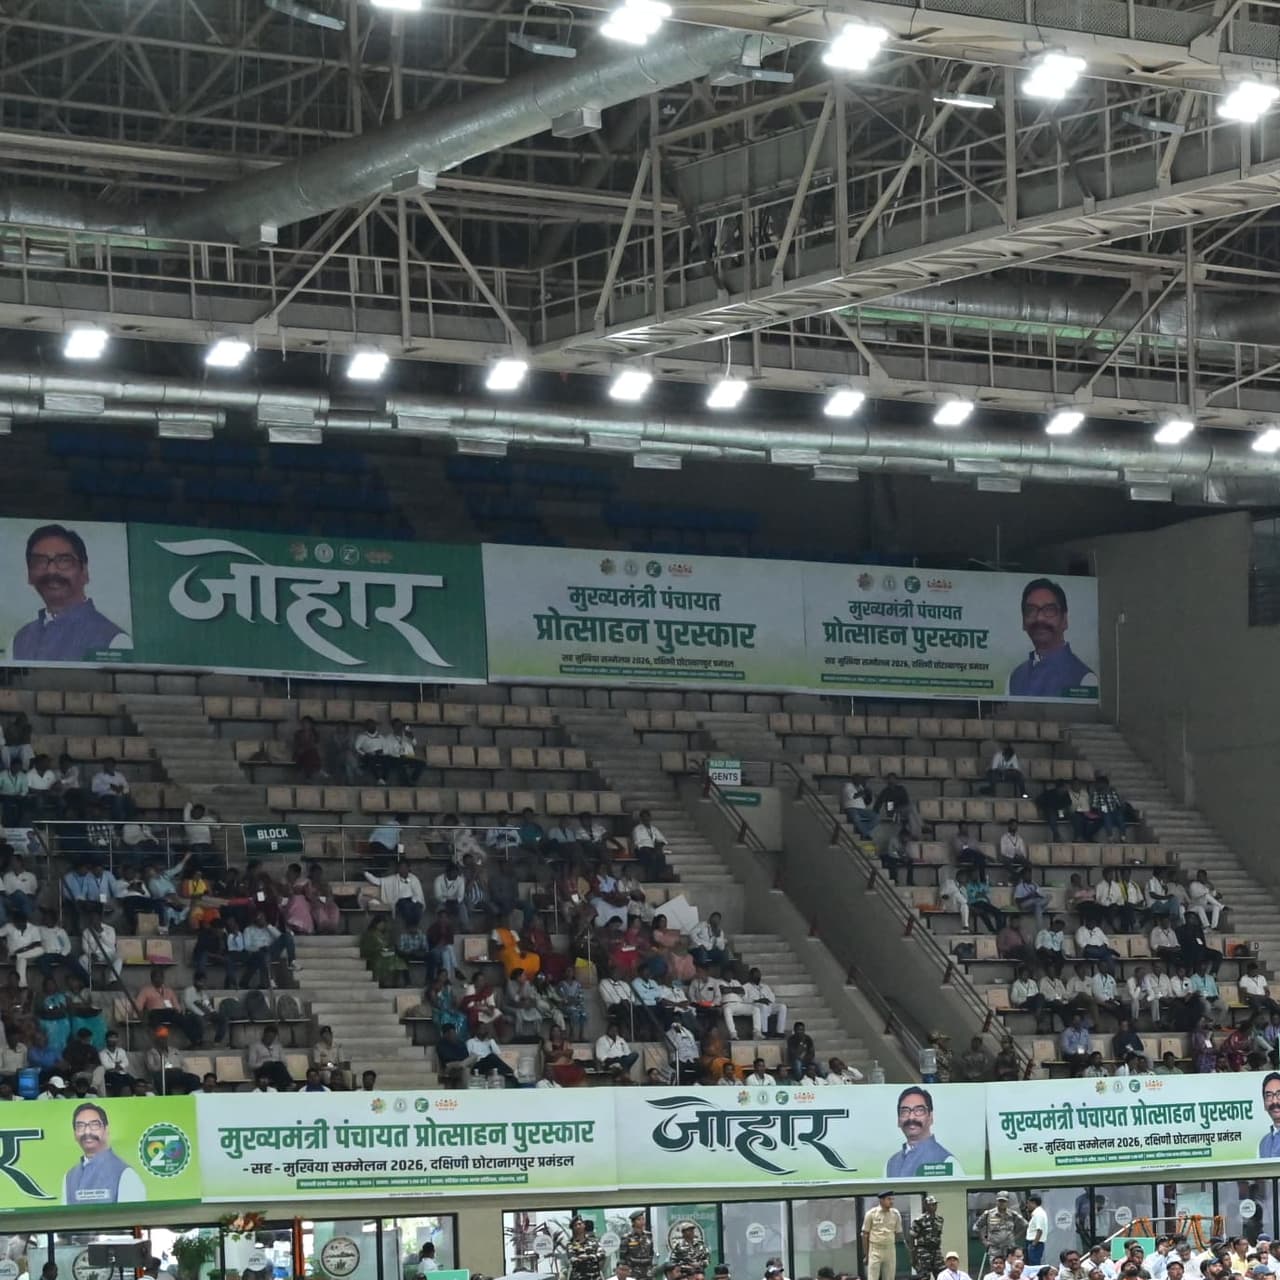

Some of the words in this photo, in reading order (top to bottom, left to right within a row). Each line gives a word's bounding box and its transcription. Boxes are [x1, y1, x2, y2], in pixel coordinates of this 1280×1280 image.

[154, 538, 455, 668] जोहार
[568, 585, 656, 611] मुख्यमंत्री
[660, 587, 721, 611] पंचायत
[848, 600, 914, 620] मुख्यमंत्री
[917, 602, 962, 620] पंचायत
[533, 607, 649, 644] प्रोत्साहन
[655, 620, 756, 652] पुरस्कार
[822, 615, 908, 645] प्रोत्साहन
[912, 627, 989, 653] पुरस्कार
[712, 772, 738, 781] GENTS
[257, 828, 288, 840] BLOCK
[646, 1095, 857, 1175] जोहार
[1000, 1103, 1073, 1139] मुख्यमंत्री
[1077, 1099, 1128, 1129] पंचायत
[1130, 1100, 1196, 1125] प्रोत्साहन
[1198, 1100, 1253, 1127] पुरस्कार
[218, 1118, 329, 1159] मुख्यमंत्री
[333, 1119, 409, 1150] पंचायत
[414, 1116, 507, 1147] प्रोत्साहन
[512, 1120, 595, 1154] पुरस्कार
[1045, 1140, 1076, 1154] मुखिया
[1077, 1138, 1114, 1151] सम्मेलन
[1144, 1134, 1171, 1146] दक्षिणी
[1173, 1132, 1216, 1146] छोटानागपुर
[1217, 1132, 1241, 1141] प्रमंडल
[283, 1159, 329, 1176] मुखिया
[332, 1158, 387, 1172] सम्मेलन
[430, 1156, 469, 1169] दक्षिणी
[472, 1155, 535, 1171] छोटानागपुर
[538, 1154, 574, 1167] प्रमंडल
